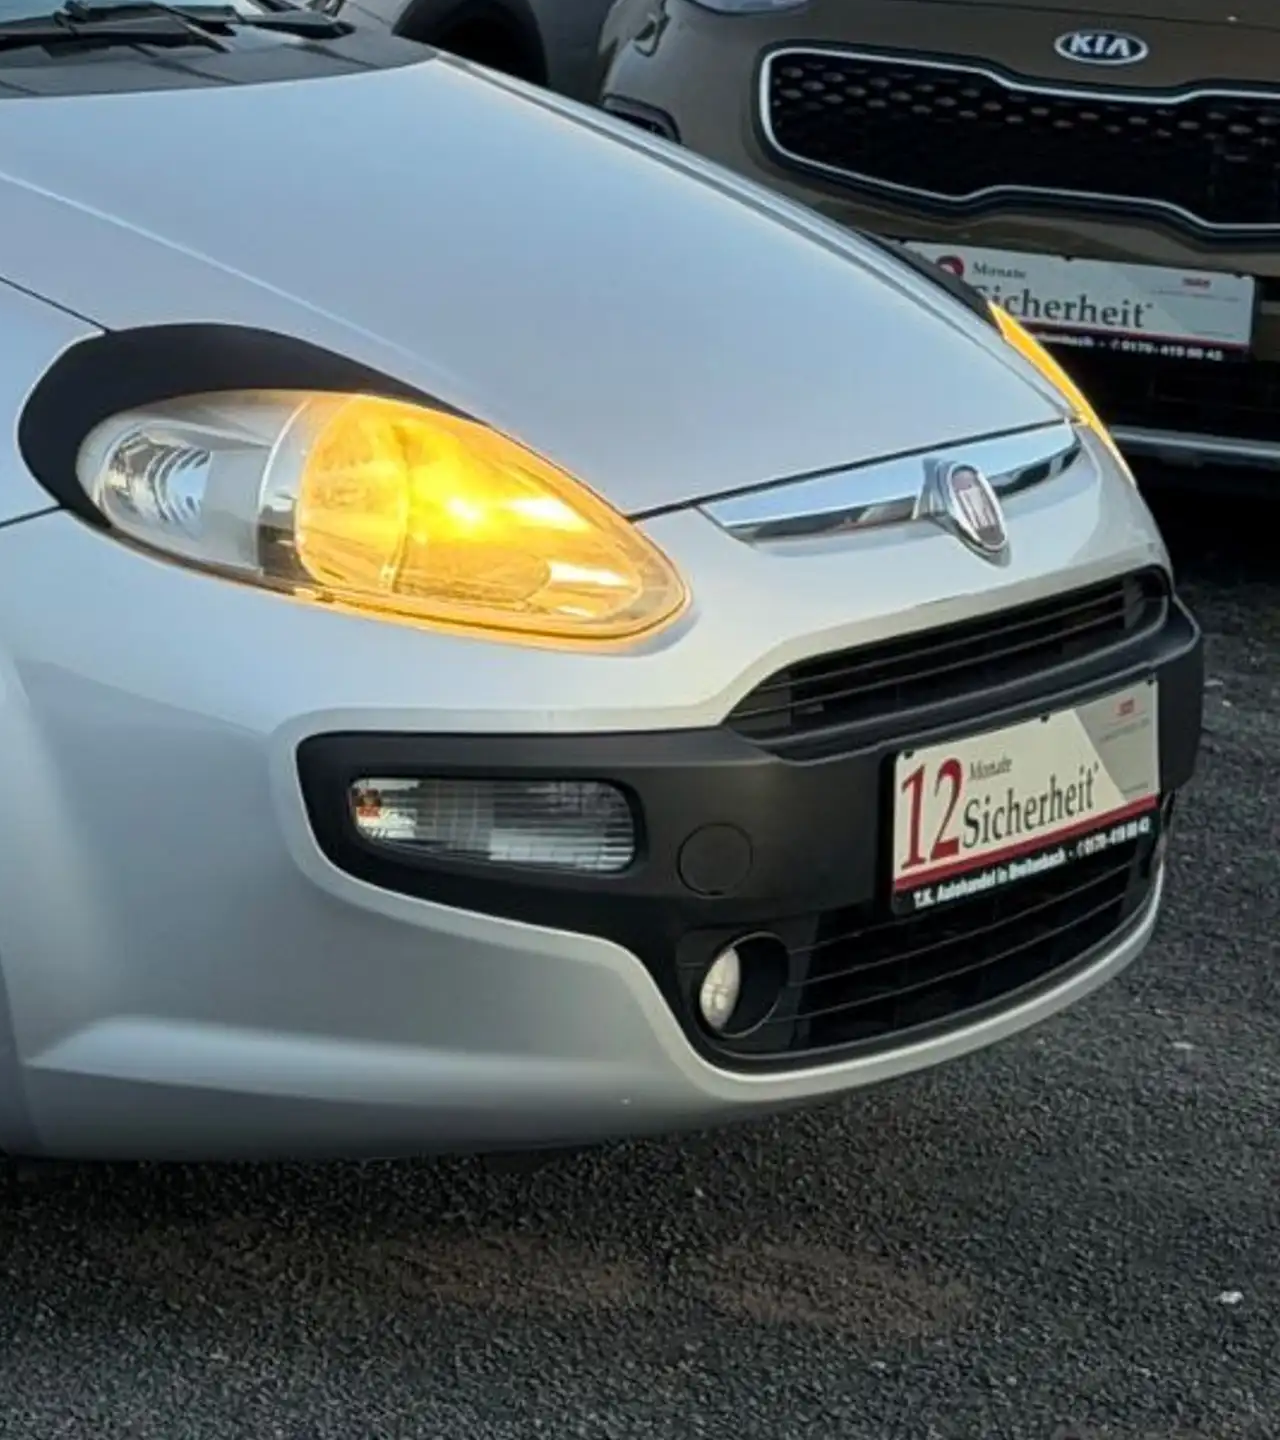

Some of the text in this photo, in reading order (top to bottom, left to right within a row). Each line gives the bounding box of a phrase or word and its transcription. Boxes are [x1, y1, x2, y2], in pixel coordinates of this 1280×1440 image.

[1069, 32, 1131, 58] KIA
[972, 284, 1144, 328] icherheit
[901, 758, 962, 869] 12
